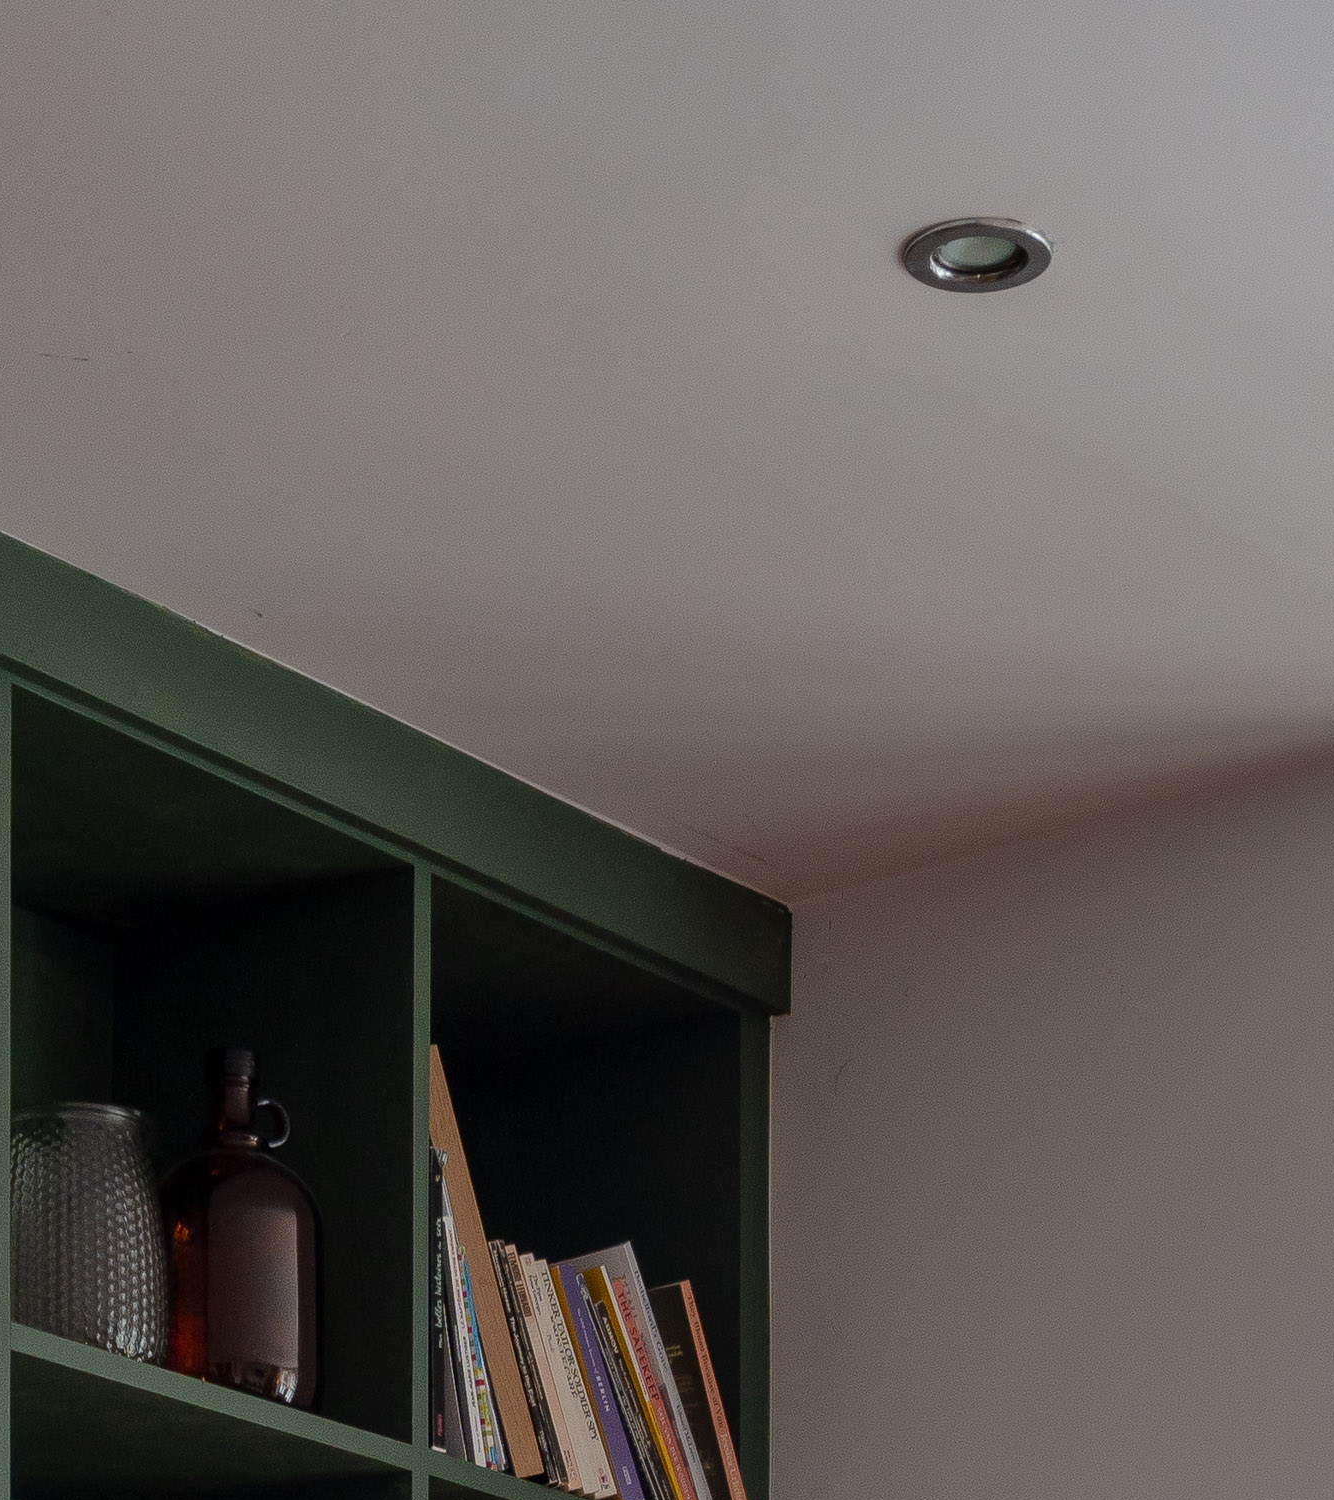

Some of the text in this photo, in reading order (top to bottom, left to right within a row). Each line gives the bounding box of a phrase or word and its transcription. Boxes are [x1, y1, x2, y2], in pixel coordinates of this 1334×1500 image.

[542, 1269, 561, 1321] TINKER
[557, 1321, 576, 1371] TAILOR
[570, 1368, 593, 1420] SOLDIER
[586, 1421, 599, 1441] SPY
[596, 1375, 611, 1411] BERLIN
[616, 1291, 660, 1402] THE SAFEKEEP
